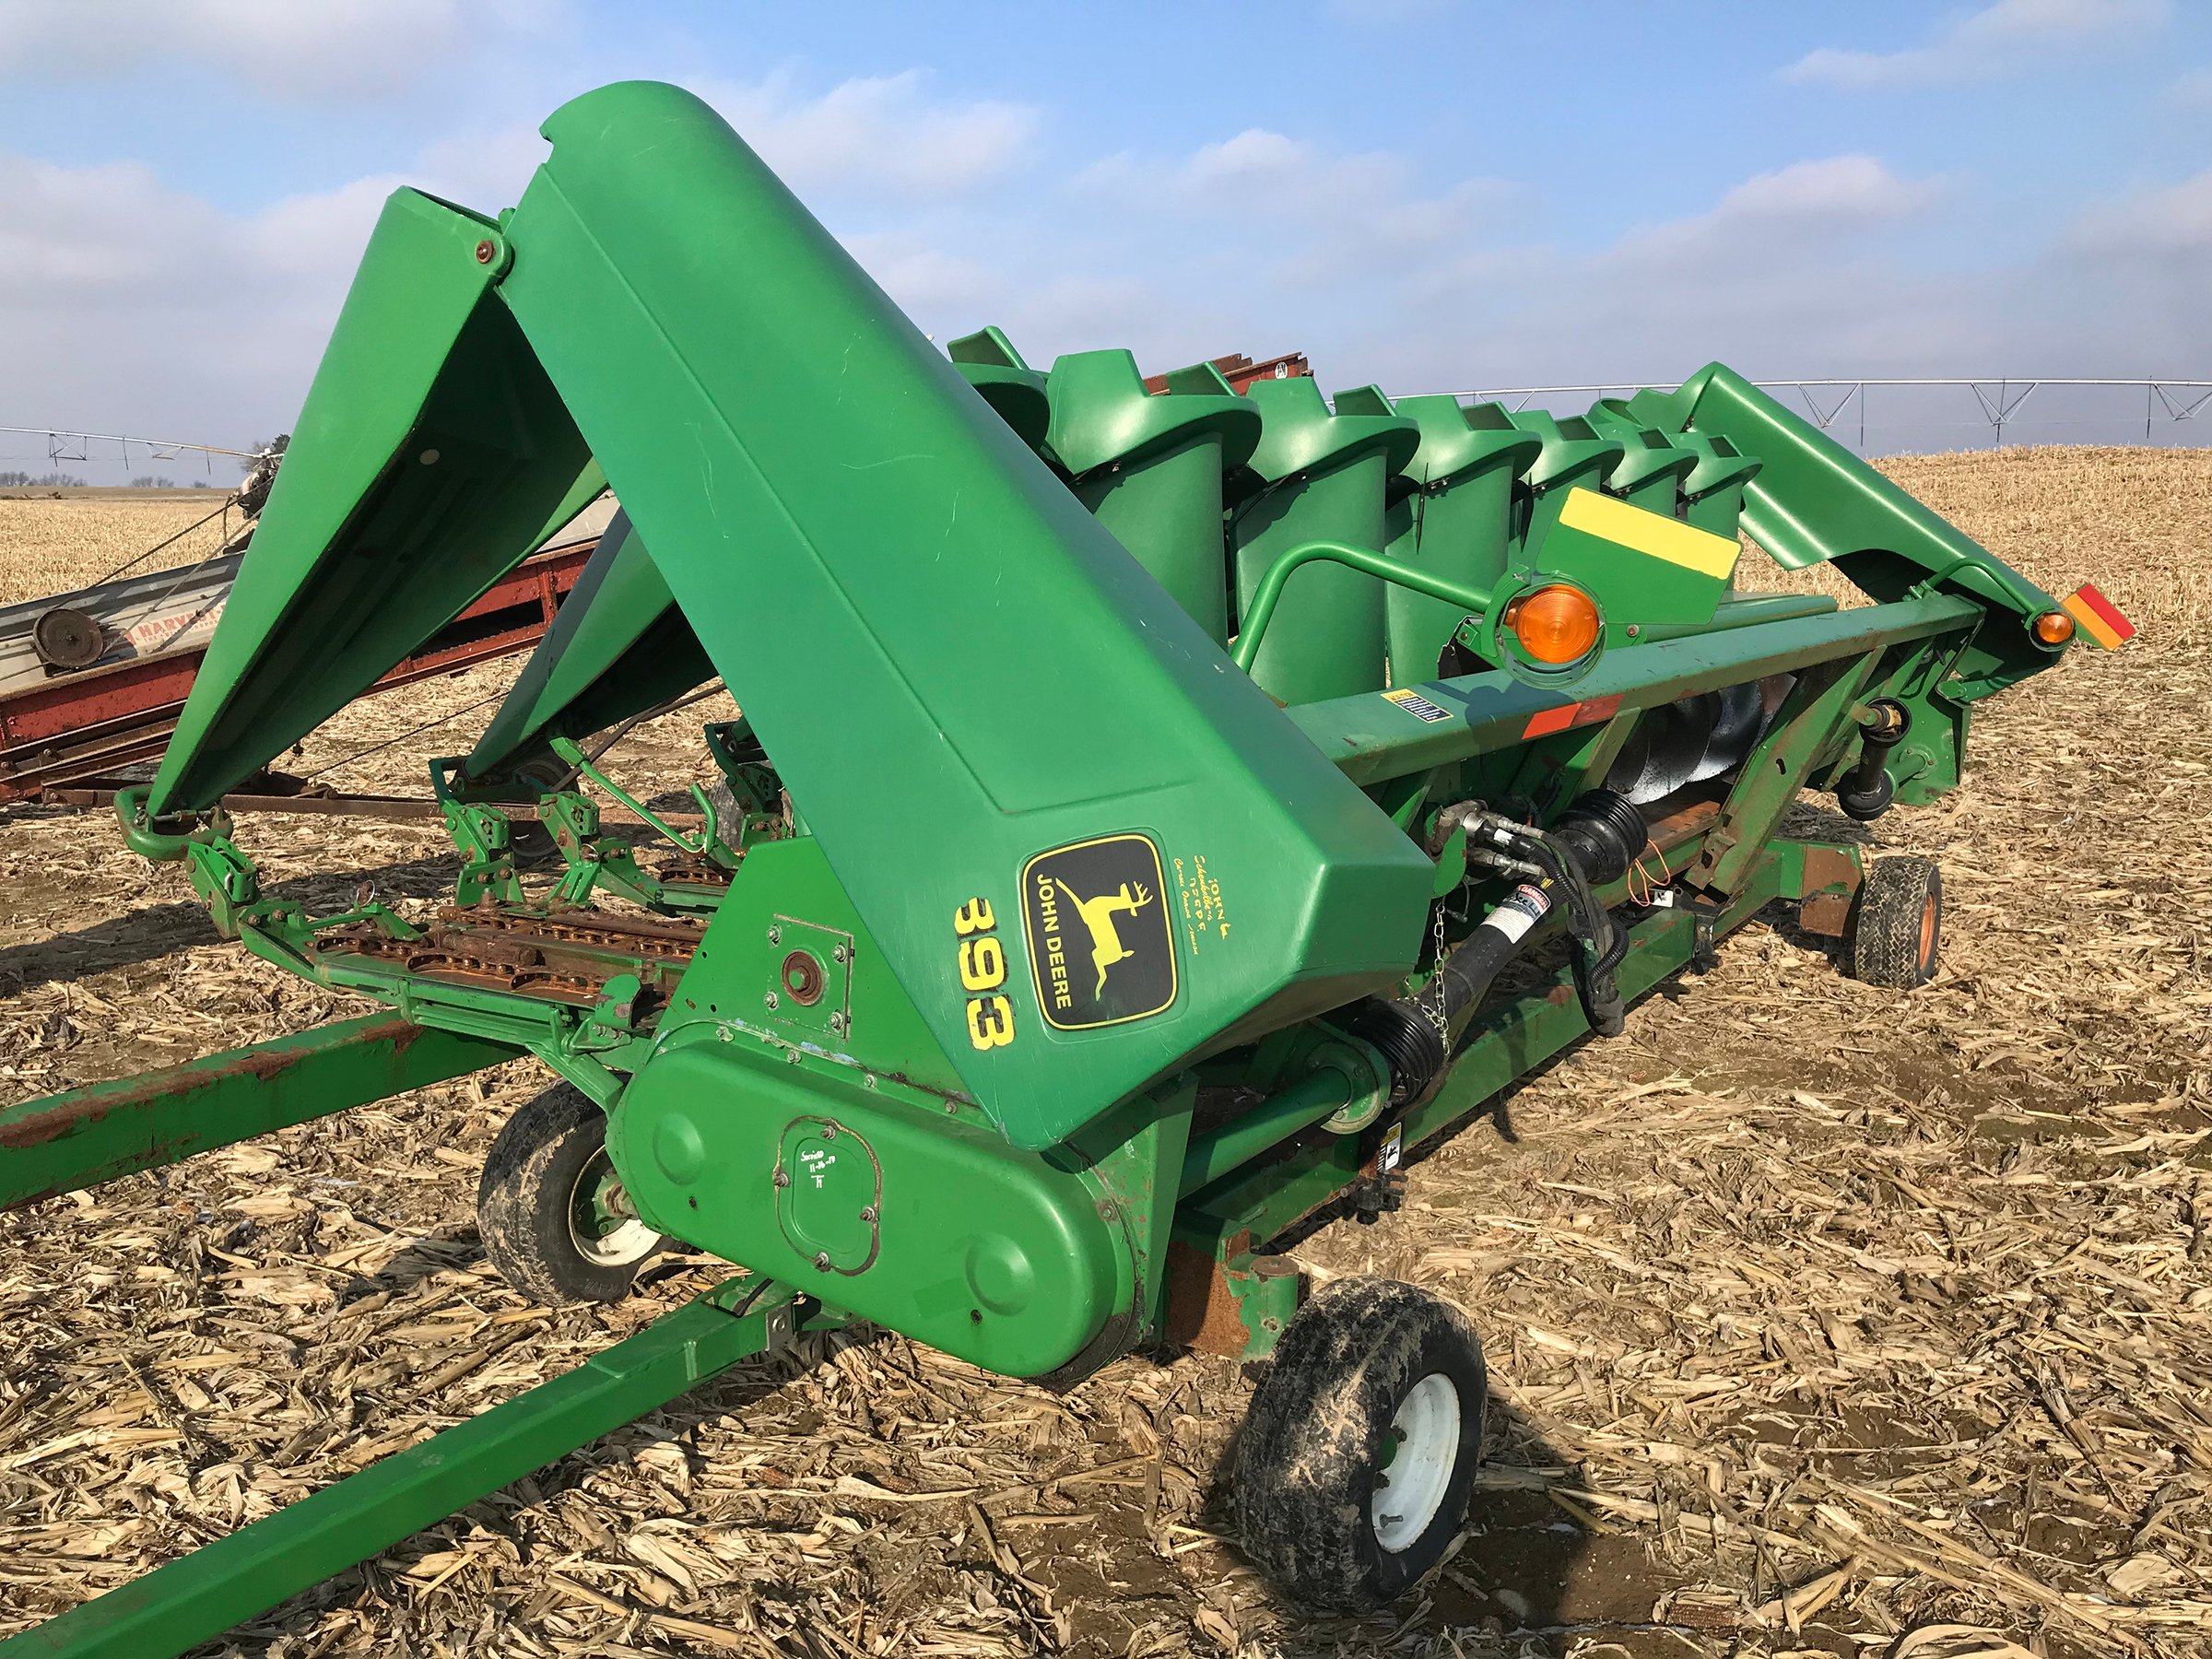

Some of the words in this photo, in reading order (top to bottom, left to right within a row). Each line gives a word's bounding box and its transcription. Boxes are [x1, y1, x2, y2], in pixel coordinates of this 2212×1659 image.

[1036, 874, 1059, 933] JOHN
[1521, 886, 1548, 909] DANGER
[954, 897, 1017, 1051] 393
[1046, 936, 1072, 1010] DEERE
